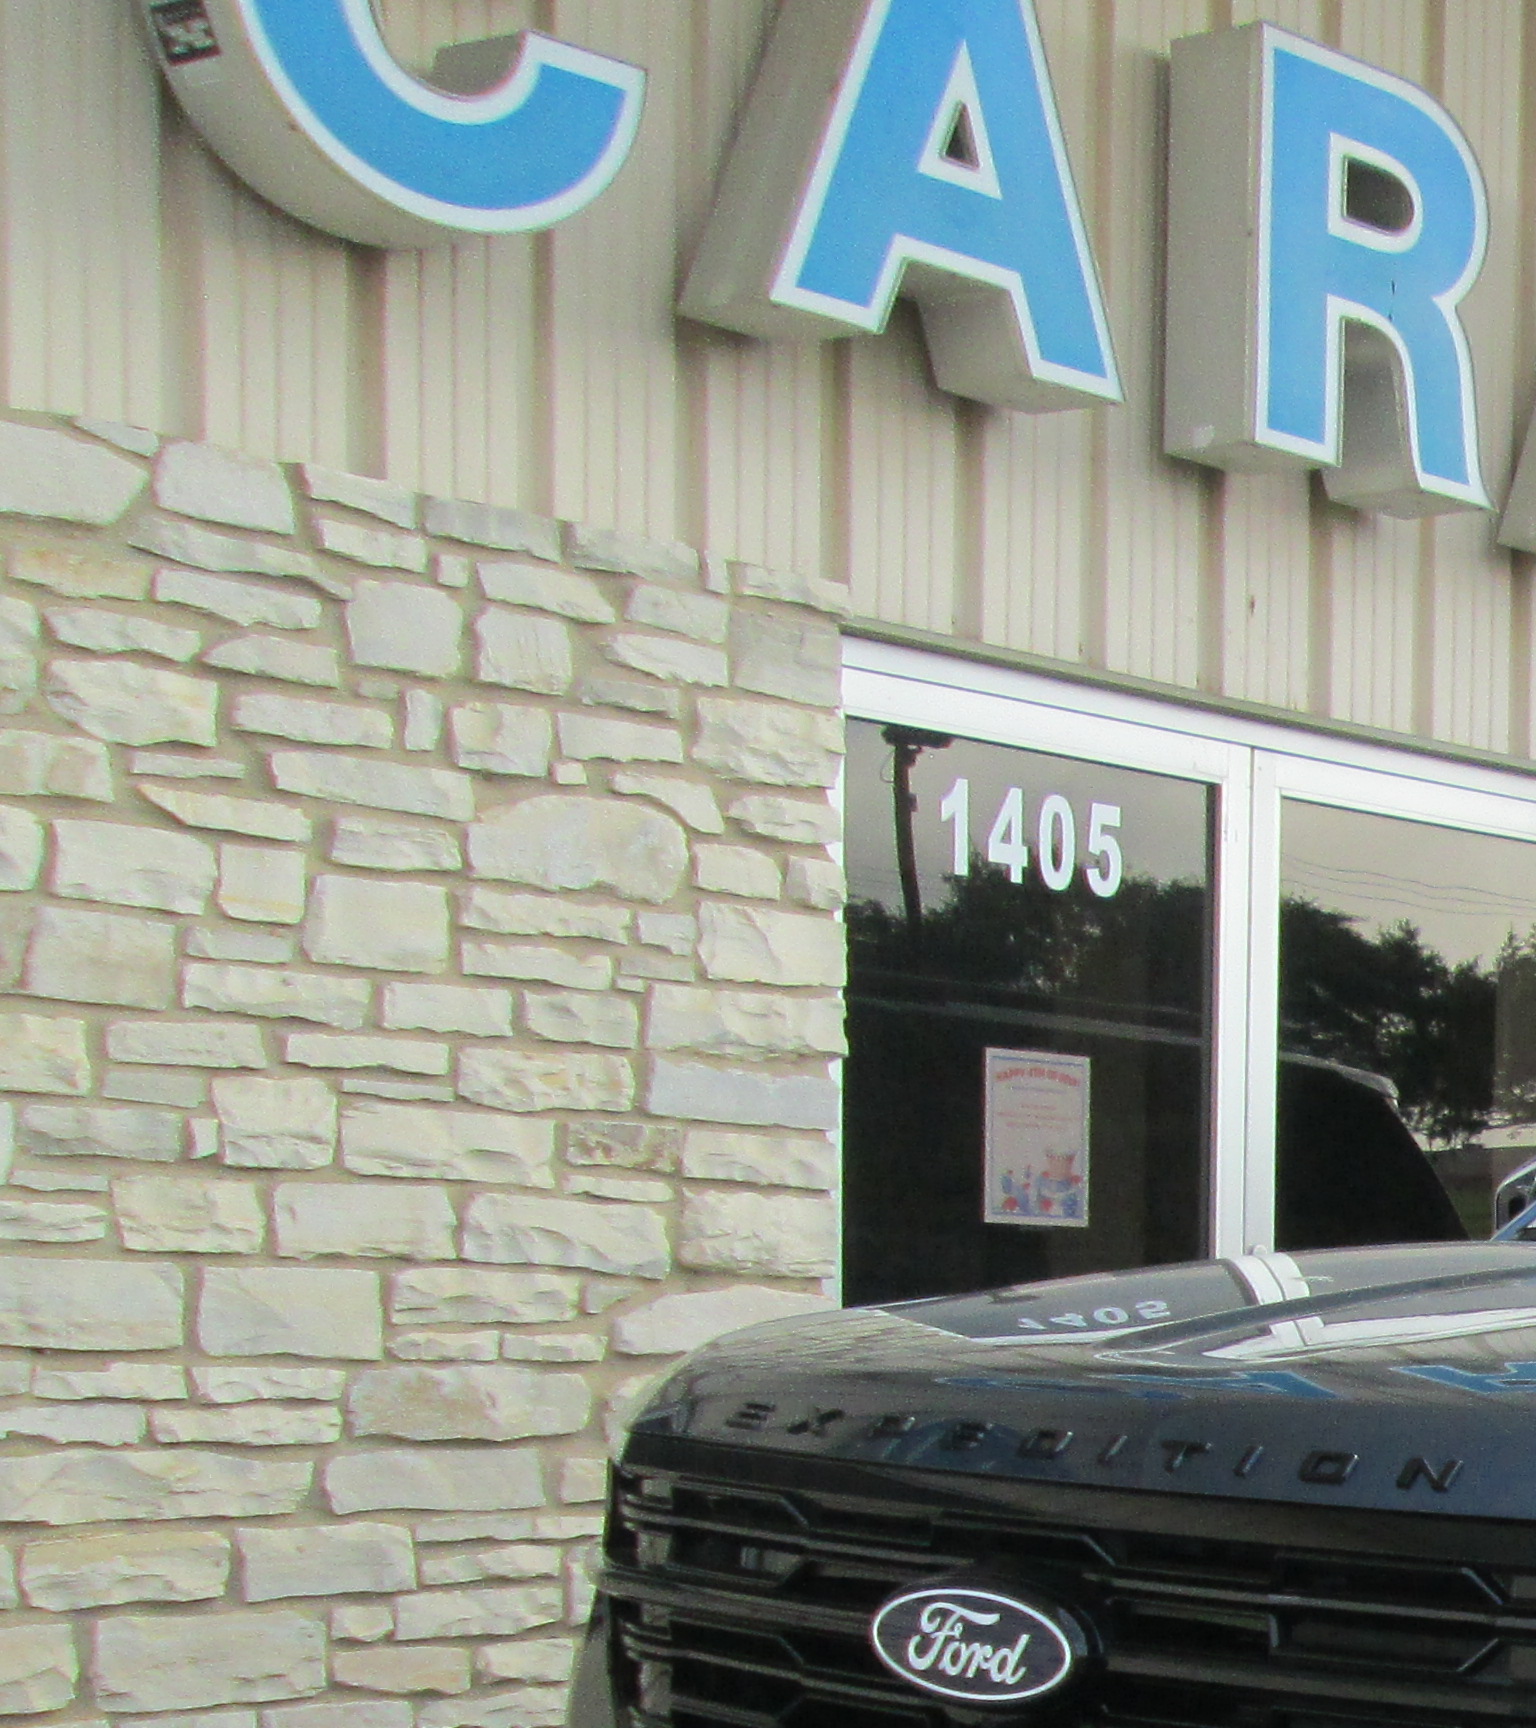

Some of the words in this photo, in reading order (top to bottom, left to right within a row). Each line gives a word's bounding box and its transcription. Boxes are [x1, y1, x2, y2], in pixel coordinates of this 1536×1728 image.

[940, 777, 1123, 898] 1405
[724, 1402, 1464, 1493] EXPEDITION
[907, 1601, 1032, 1686] Ford
